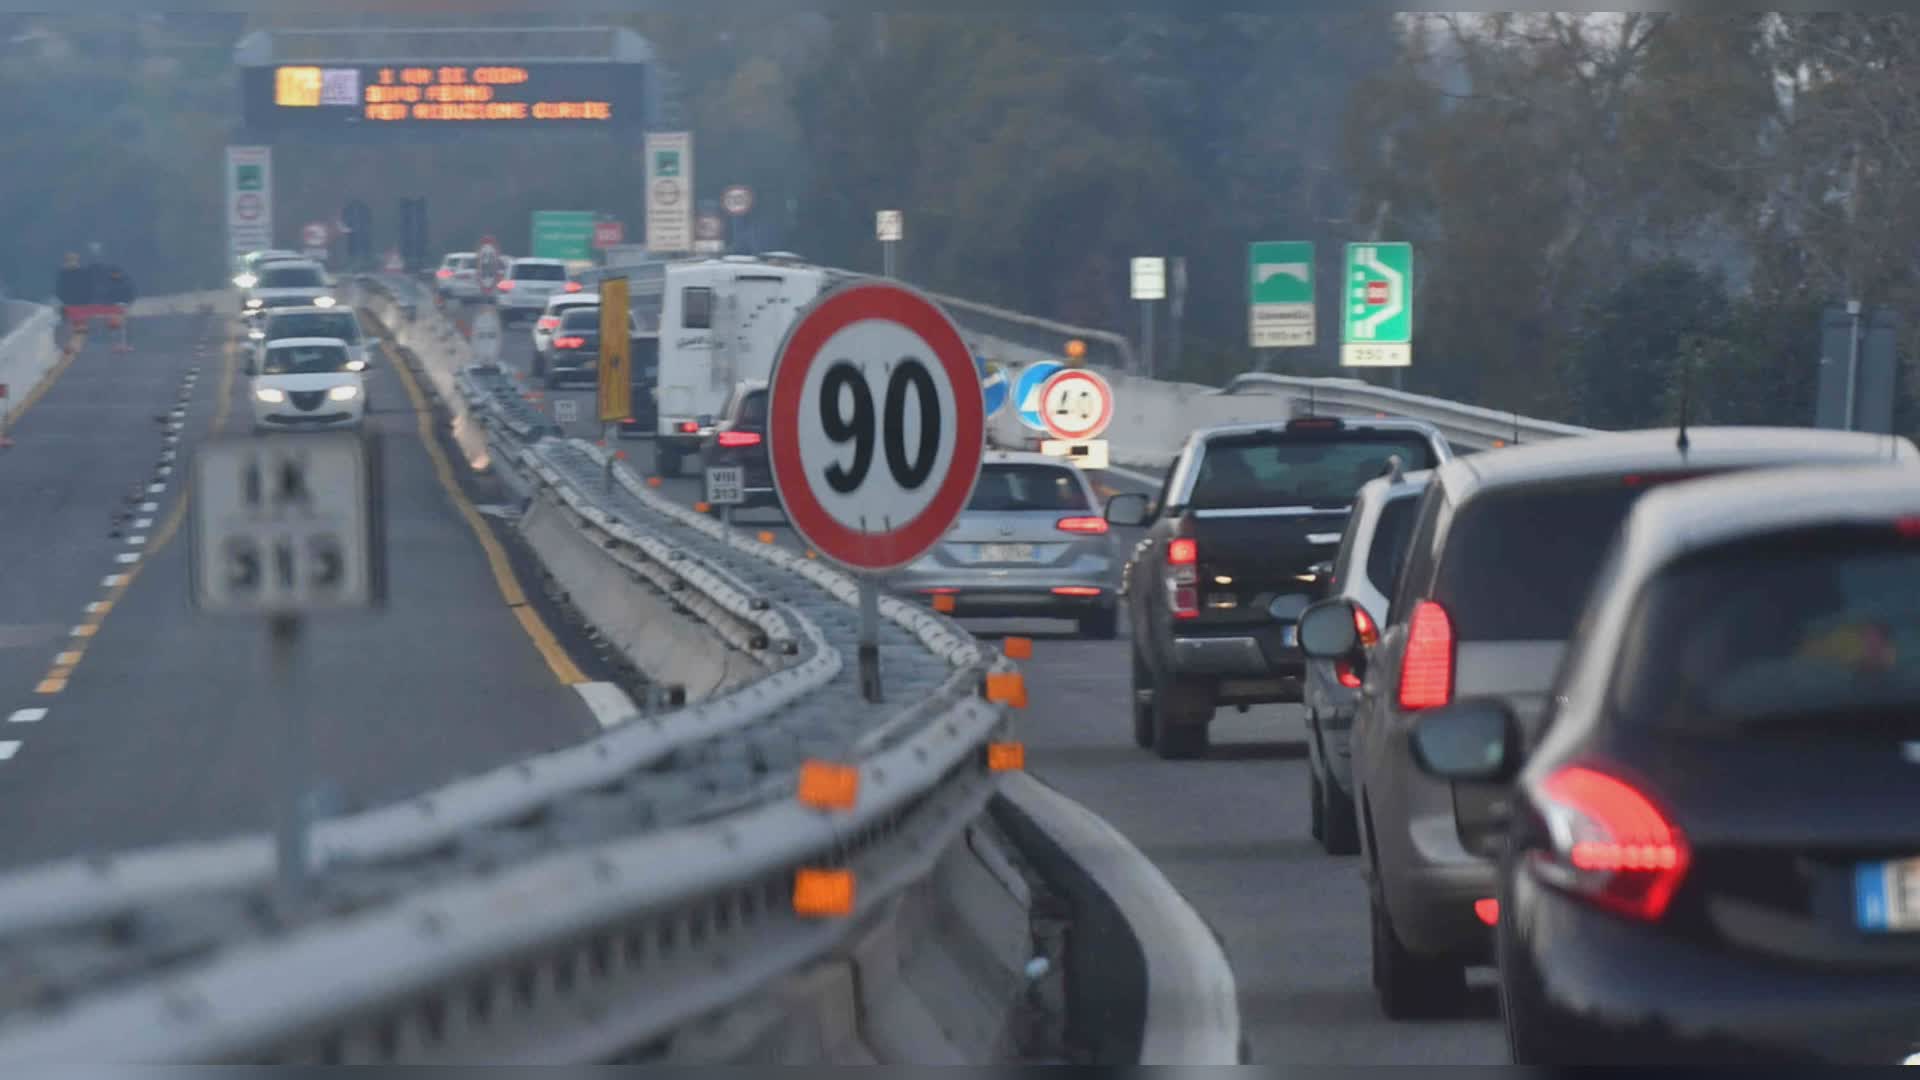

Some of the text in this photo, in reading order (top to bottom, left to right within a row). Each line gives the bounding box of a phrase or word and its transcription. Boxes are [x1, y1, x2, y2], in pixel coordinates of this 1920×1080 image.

[365, 102, 408, 121] PER
[412, 102, 528, 120] RIDUZIONE
[819, 357, 942, 495] 90
